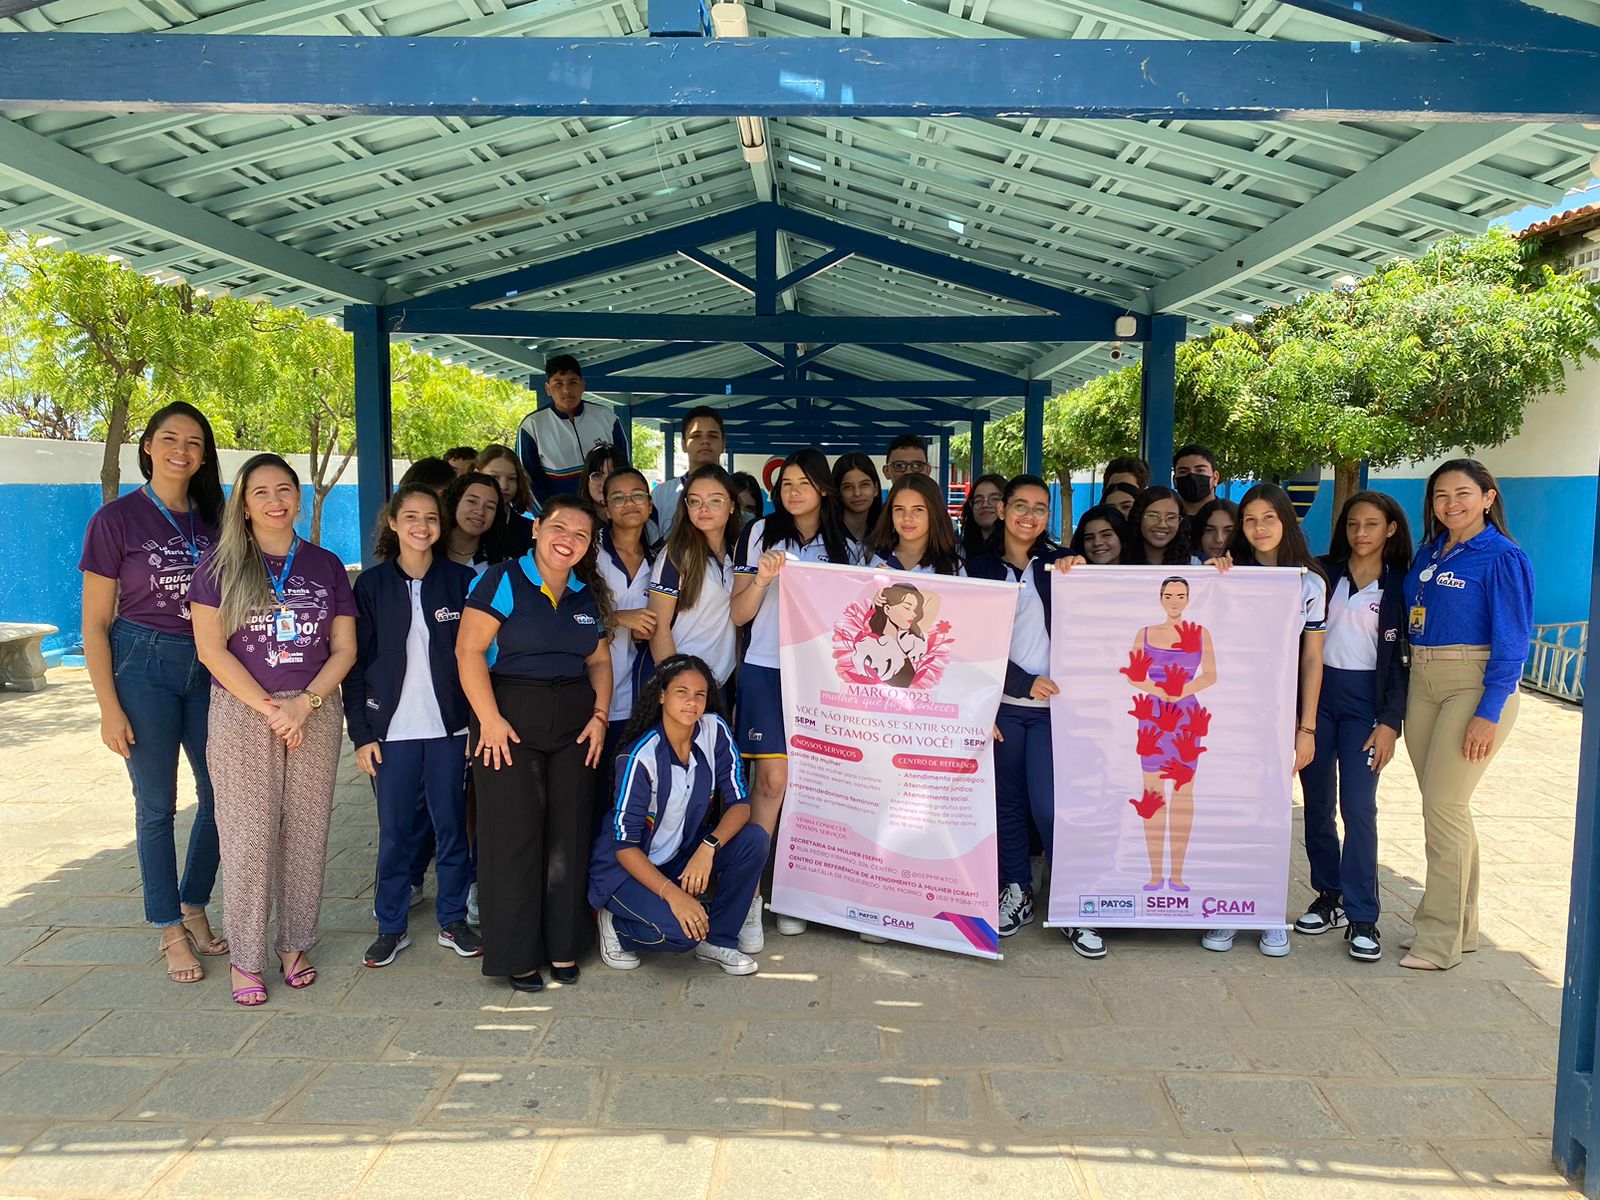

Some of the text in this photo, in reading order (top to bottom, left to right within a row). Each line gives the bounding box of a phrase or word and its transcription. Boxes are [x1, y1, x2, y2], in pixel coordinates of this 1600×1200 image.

[159, 574, 193, 584] EDUCA
[1439, 580, 1464, 588] AGAPE
[650, 583, 680, 596] GAPE
[250, 624, 266, 632] SEM
[267, 622, 318, 636] MDO!
[821, 690, 858, 705] mulher
[862, 697, 882, 708] que
[848, 685, 930, 704] MARÇO 2023
[795, 716, 816, 726] SEPM
[796, 704, 986, 736] VOCÊ NÃO PRECISA SE SENTIR SOZINHA
[824, 724, 880, 742] ESTAMOS
[882, 734, 912, 745] COM
[916, 736, 953, 748] VOCÊ!
[796, 739, 857, 758] NOSSOS SERVIÇOS
[964, 738, 986, 747] SEPM
[898, 758, 927, 766] CENTRO
[904, 773, 951, 782] Atendimento
[904, 782, 950, 792] Atendimento
[903, 792, 950, 800] Atendimento
[790, 836, 826, 849] SECRETARIA
[837, 847, 861, 858] MULHER
[862, 853, 883, 864] (SEPM)
[789, 854, 814, 864] CENTRO
[824, 862, 860, 876] REFERÊNCIA
[870, 874, 917, 887] ATENDIMENTO
[924, 884, 952, 894] MULHER
[953, 888, 978, 898] (CRAM)
[1101, 900, 1133, 908] PATOS
[1147, 896, 1189, 908] SEPM
[1202, 897, 1255, 916] CRAM
[882, 915, 914, 929] CRAM
